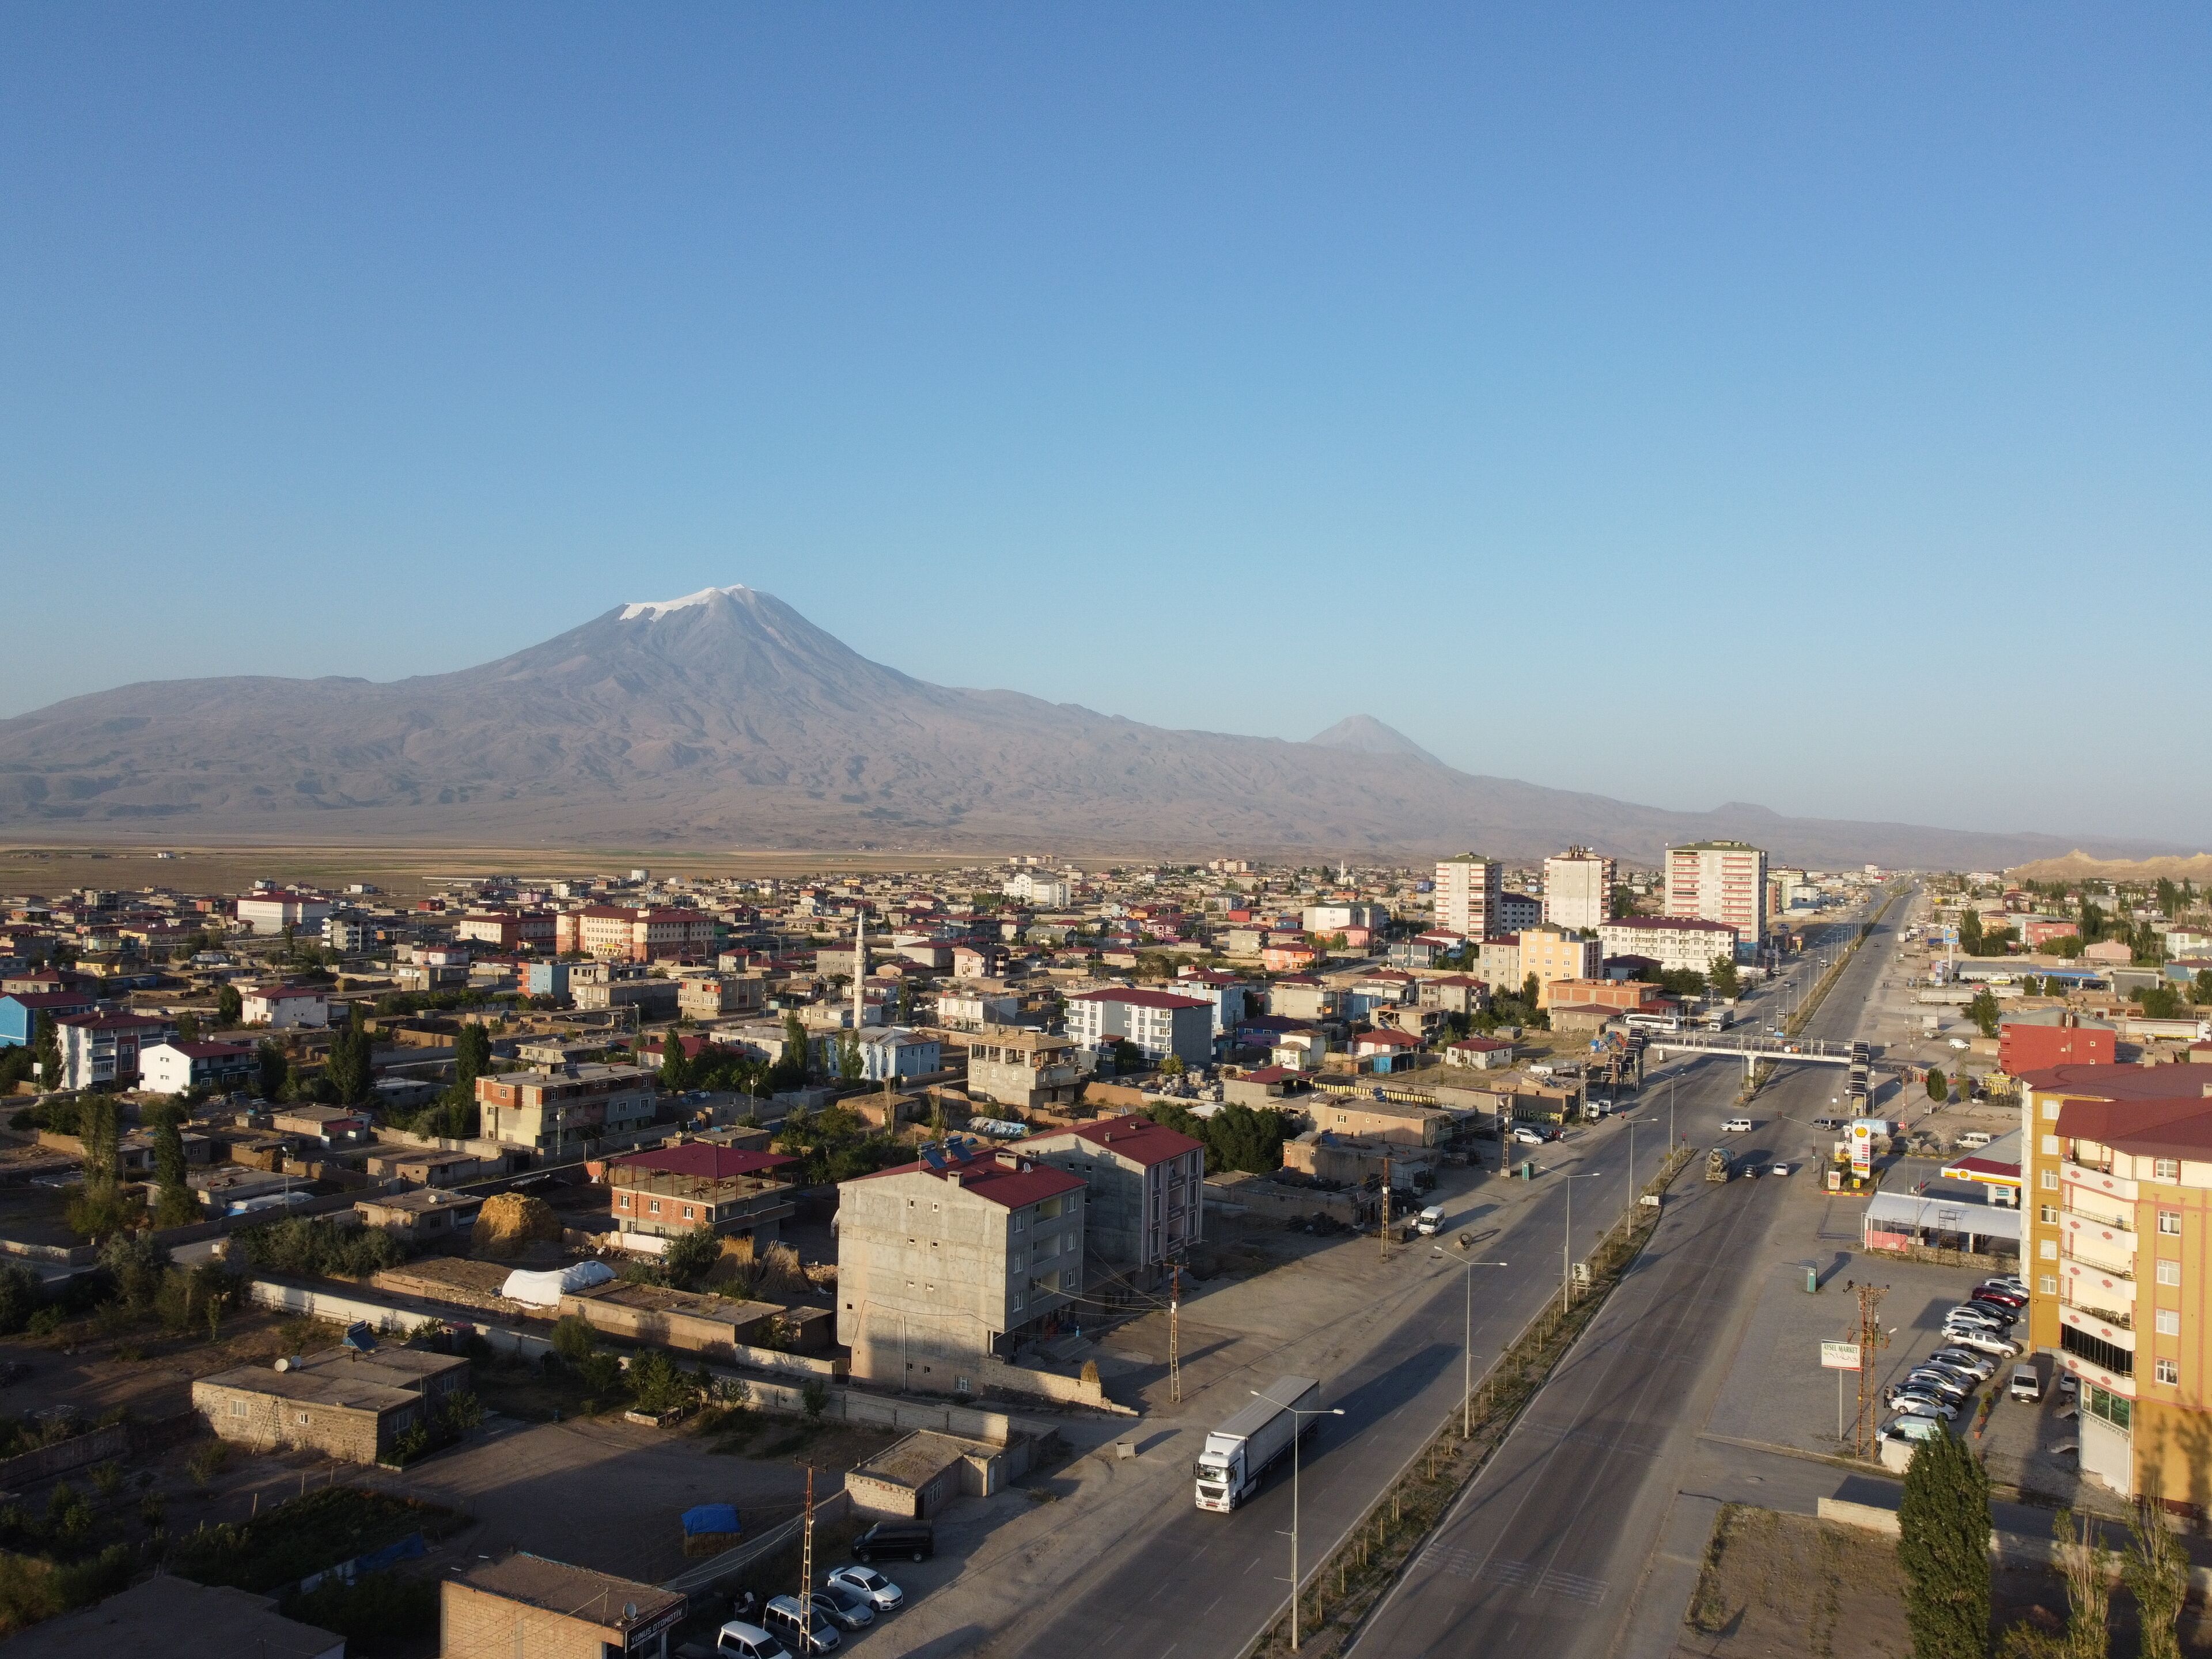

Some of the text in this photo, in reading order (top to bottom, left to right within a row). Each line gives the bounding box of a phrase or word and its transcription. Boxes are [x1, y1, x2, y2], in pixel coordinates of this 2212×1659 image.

[1824, 1343, 1857, 1354] AYSEL MARKET
[631, 1626, 652, 1644] YUNUS
[653, 1608, 683, 1631] OTOMOTİV
